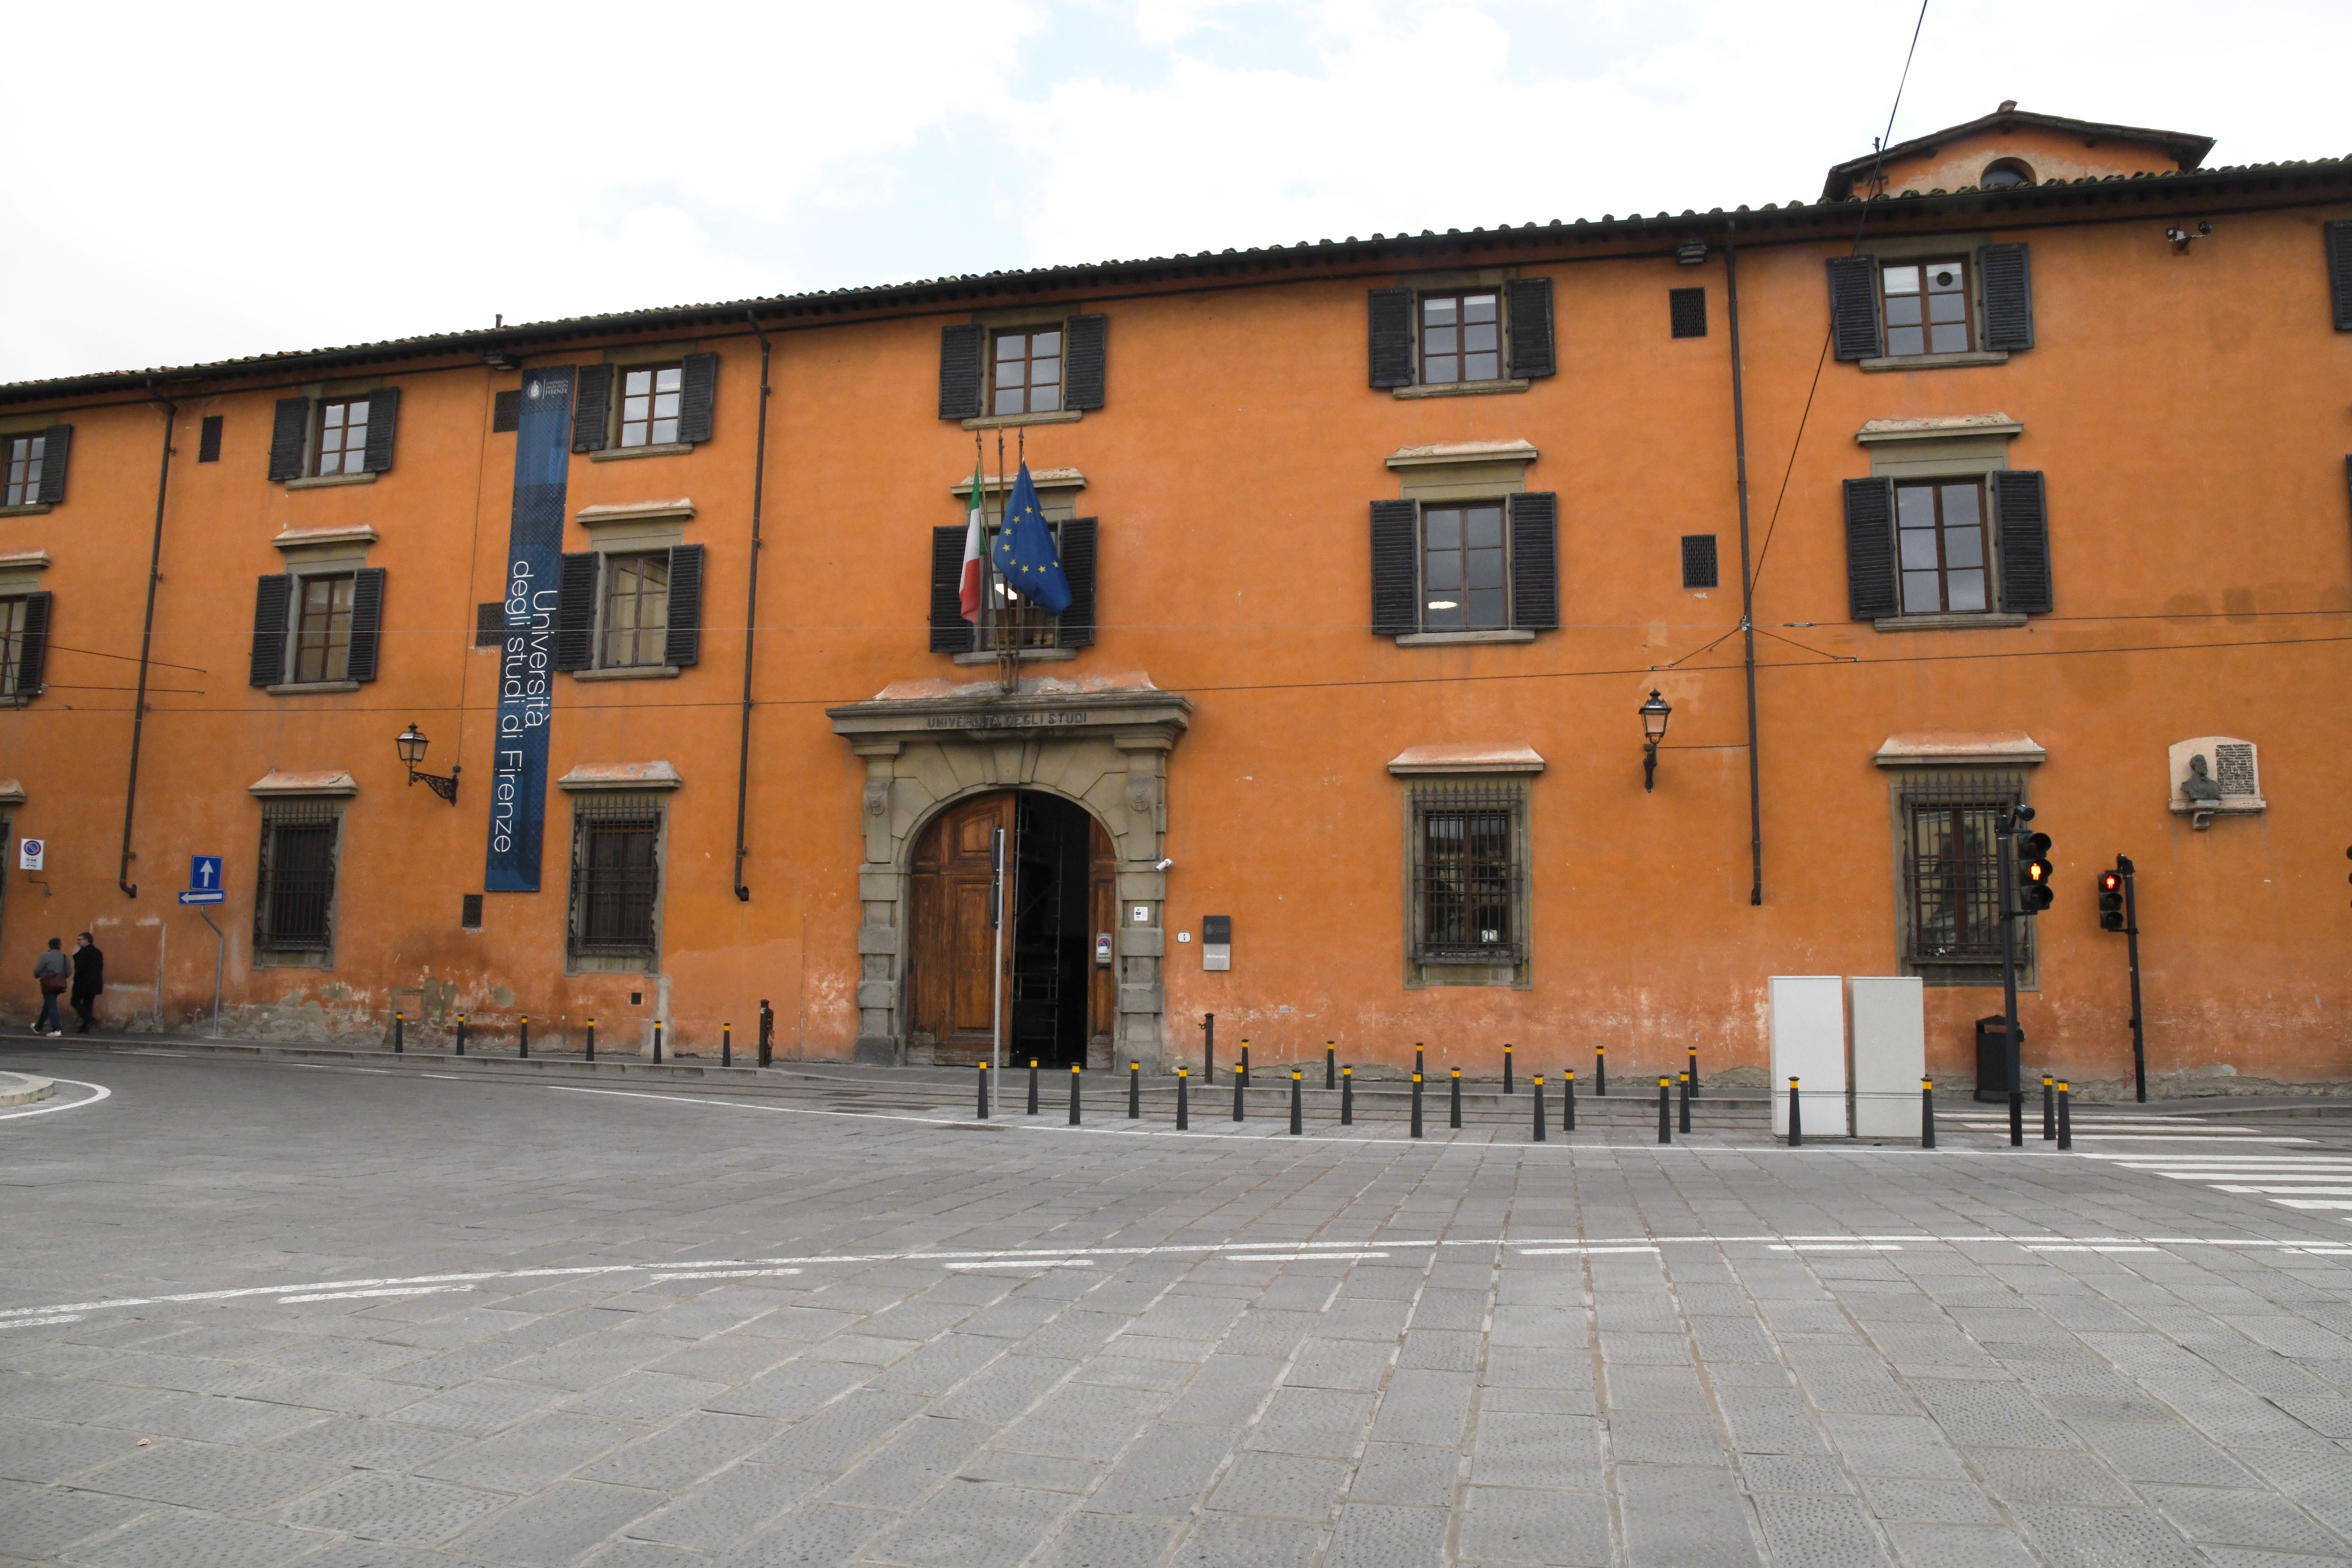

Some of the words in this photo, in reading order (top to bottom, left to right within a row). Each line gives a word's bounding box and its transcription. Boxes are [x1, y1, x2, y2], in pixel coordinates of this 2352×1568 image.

[505, 561, 534, 626] degli
[504, 637, 528, 704] studi
[525, 591, 557, 728] Università
[502, 715, 524, 739] di
[1005, 714, 1043, 726] DEGLI
[1049, 712, 1087, 724] STUDI
[494, 751, 522, 852] Firenze
